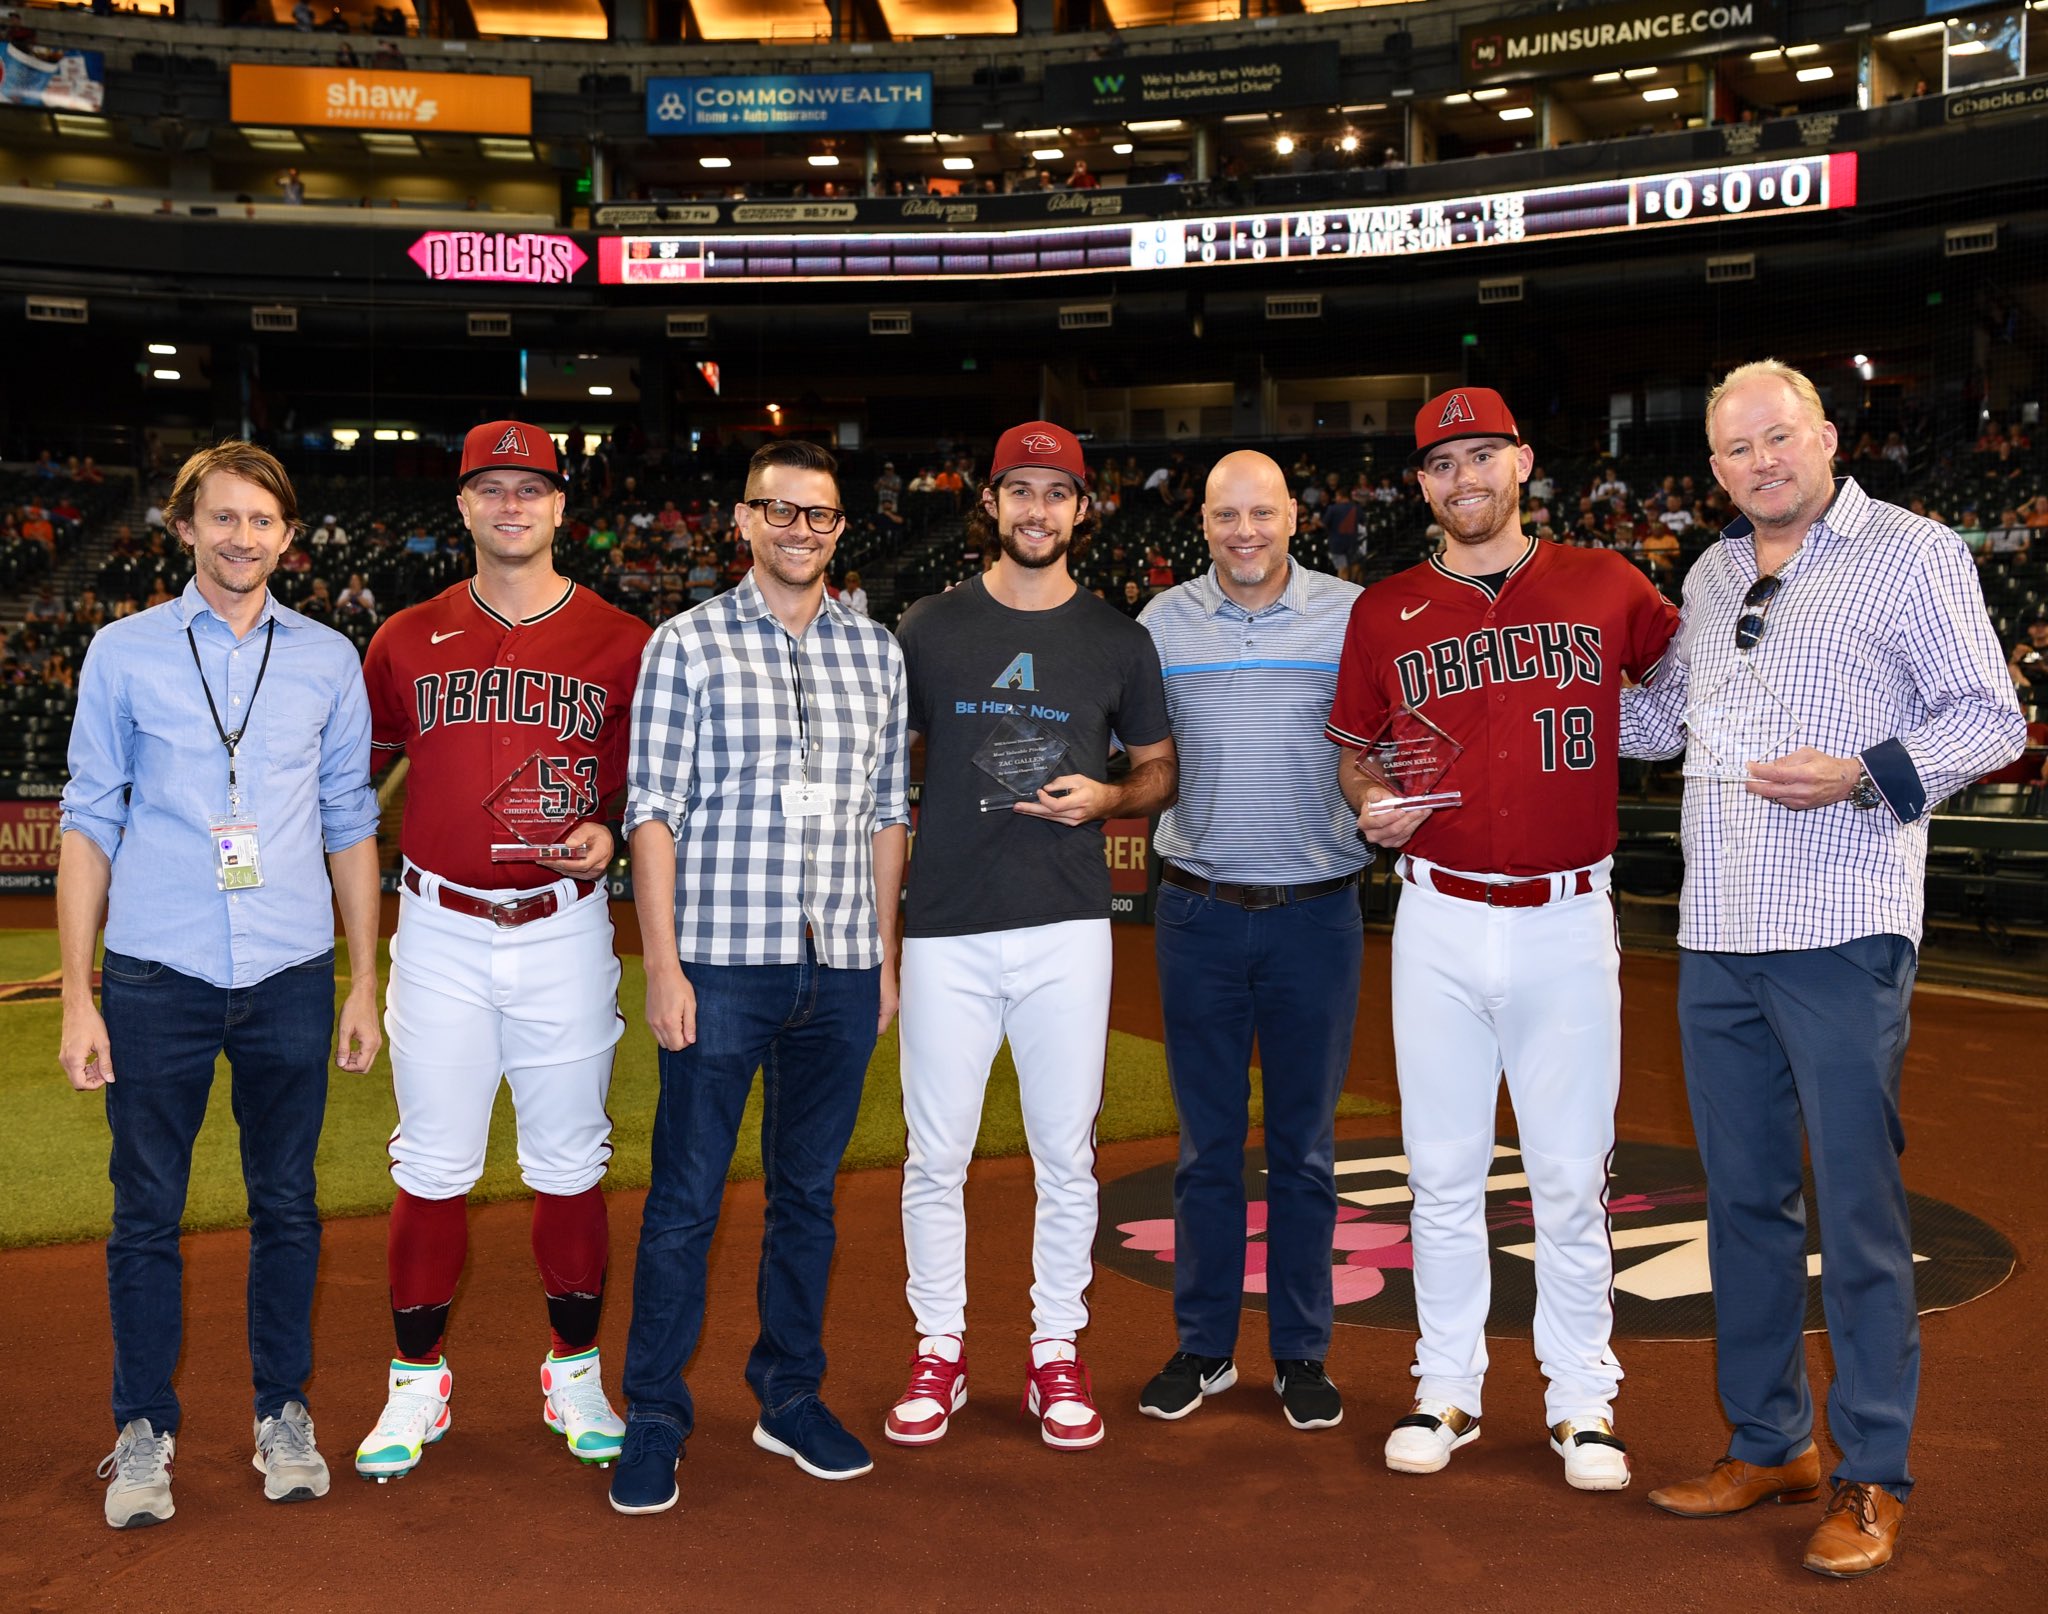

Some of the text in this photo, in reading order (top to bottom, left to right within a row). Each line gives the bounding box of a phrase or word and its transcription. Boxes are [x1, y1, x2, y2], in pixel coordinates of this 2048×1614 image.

[1506, 4, 1752, 59] MJINSURANCE.COM
[1142, 64, 1281, 86] We're building the World's
[327, 78, 417, 109] shaw
[696, 86, 923, 107] COMMONWEALTH
[1143, 88, 1170, 100] Most
[1173, 82, 1238, 99] Experienced
[697, 111, 728, 124] Home
[743, 109, 769, 122] Auto
[771, 107, 828, 122] Insurance
[1645, 191, 1660, 214] B
[1664, 178, 1693, 220] 0
[1702, 184, 1717, 206] S
[1722, 171, 1750, 213] 0
[1781, 165, 1811, 206] 0
[831, 207, 848, 217] FM
[1295, 214, 1326, 236] AB
[1349, 210, 1413, 234] WADE
[1419, 206, 1450, 228] JR.
[1472, 197, 1525, 222] .198
[1155, 227, 1166, 243] 0
[1202, 222, 1216, 242] 0
[1252, 219, 1267, 238] 0
[1310, 235, 1326, 256] P
[1347, 227, 1450, 256] JAMESON
[1474, 218, 1525, 243] 1.38
[659, 242, 680, 258] SF
[1237, 233, 1247, 249] E
[1252, 240, 1267, 259] 0
[707, 251, 715, 267] 1
[1155, 249, 1166, 264] 0
[1202, 243, 1216, 263] 0
[660, 265, 686, 278] ARI
[1533, 706, 1596, 772] 18
[1014, 756, 1045, 765] GALLEN
[1383, 757, 1438, 769] CARSON KELLY
[538, 756, 599, 820] 53
